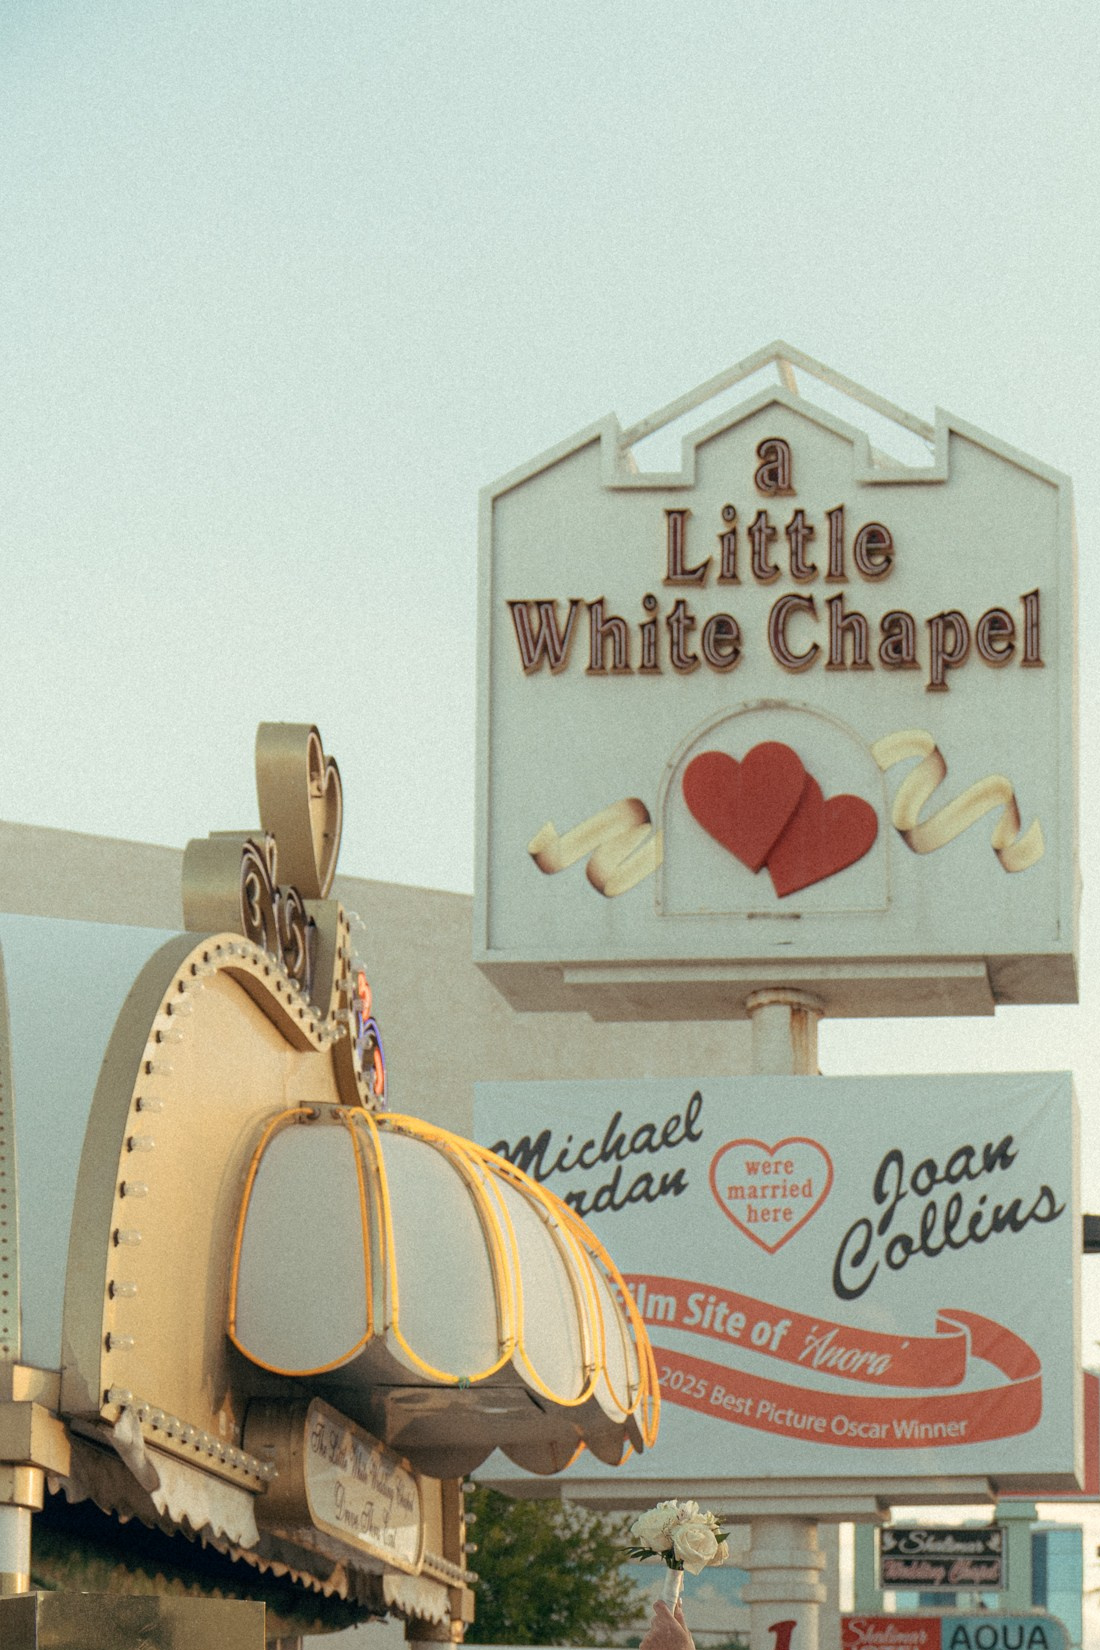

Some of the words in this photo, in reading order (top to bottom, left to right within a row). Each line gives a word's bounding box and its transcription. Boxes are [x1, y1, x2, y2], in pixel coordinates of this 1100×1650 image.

[755, 437, 796, 496] a
[662, 504, 894, 586] Little
[507, 594, 743, 676] White
[768, 589, 1045, 691] Chapel
[486, 1090, 703, 1183] Michael
[745, 1158, 794, 1176] were
[562, 1165, 688, 1218] rdan
[727, 1180, 813, 1200] married
[746, 1204, 793, 1223] here
[874, 1135, 1019, 1236] Joan
[833, 1185, 1066, 1300] Collins
[682, 1292, 747, 1339] Site
[751, 1319, 792, 1351] of
[658, 1366, 709, 1399] 2025
[709, 1384, 754, 1421] Best
[755, 1399, 827, 1432] Picture
[831, 1414, 890, 1439] Oscar
[891, 1418, 969, 1440] Winner
